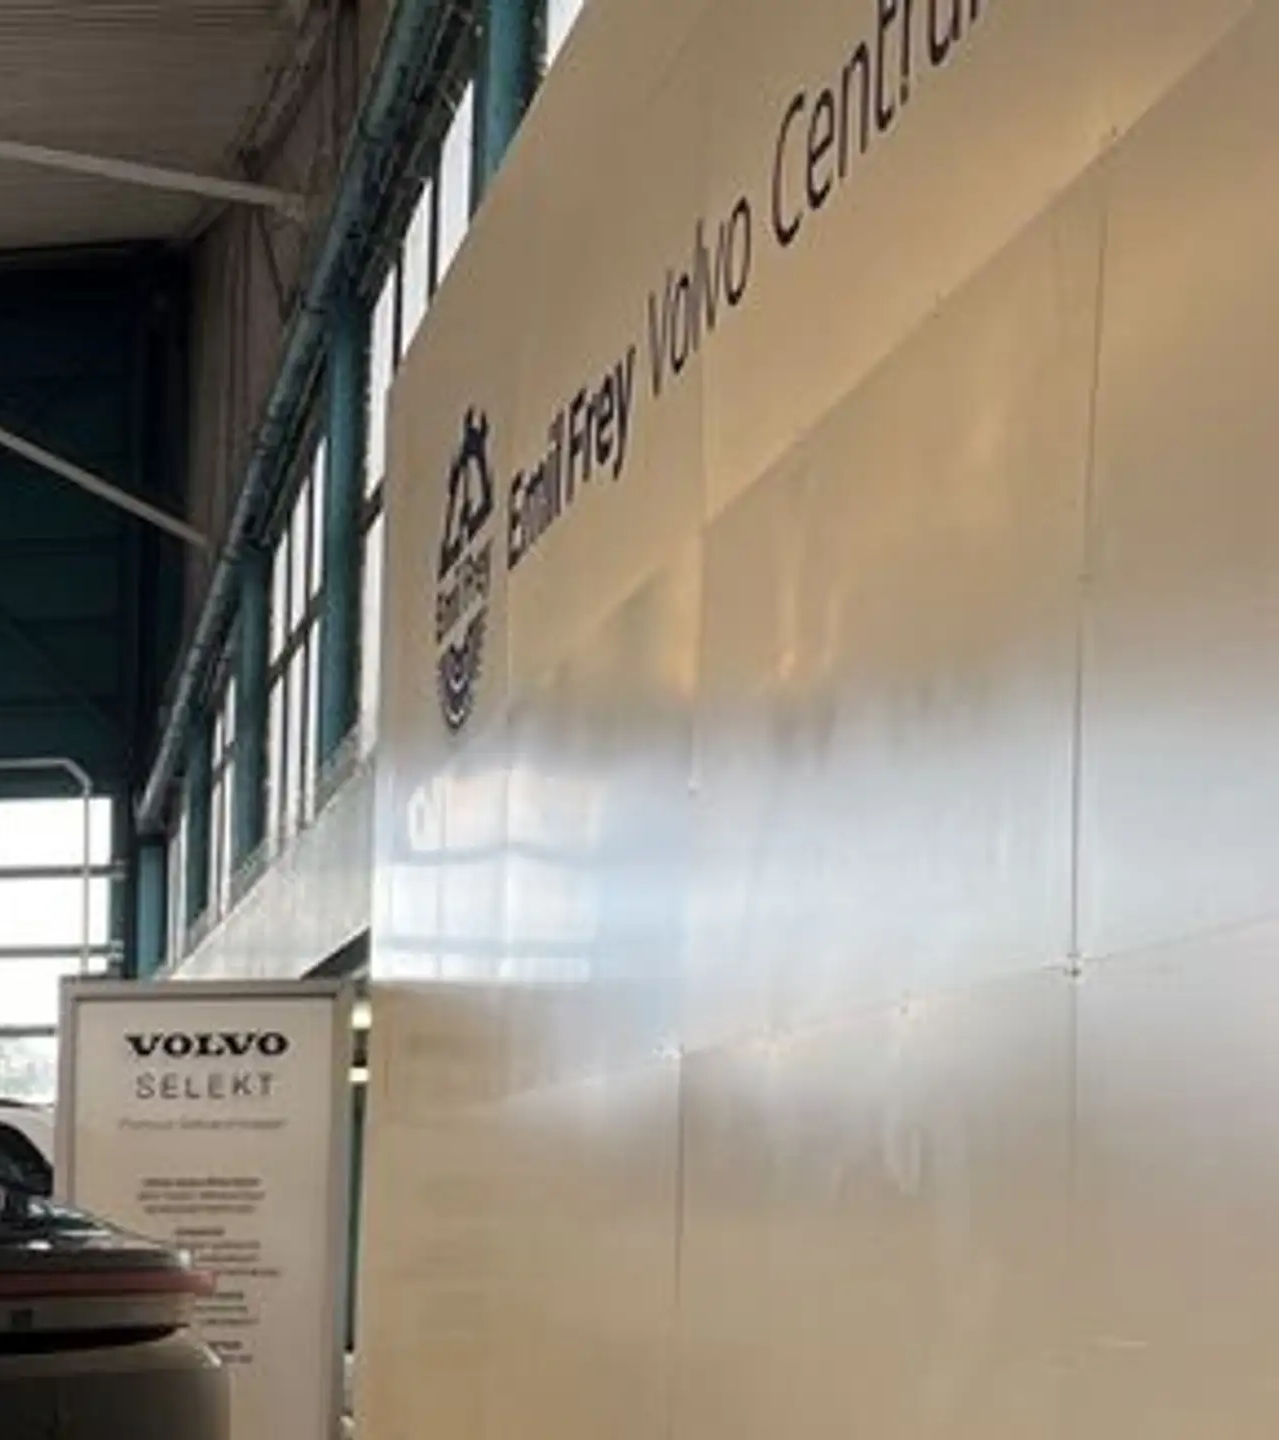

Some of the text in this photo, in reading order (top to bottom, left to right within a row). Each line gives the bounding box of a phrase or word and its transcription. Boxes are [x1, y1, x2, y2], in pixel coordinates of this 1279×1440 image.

[565, 344, 635, 505] Frey
[648, 196, 751, 398] Volvo
[771, 0, 979, 248] Centru
[124, 1032, 290, 1058] VOLVO
[135, 1071, 273, 1100] SELEKT
